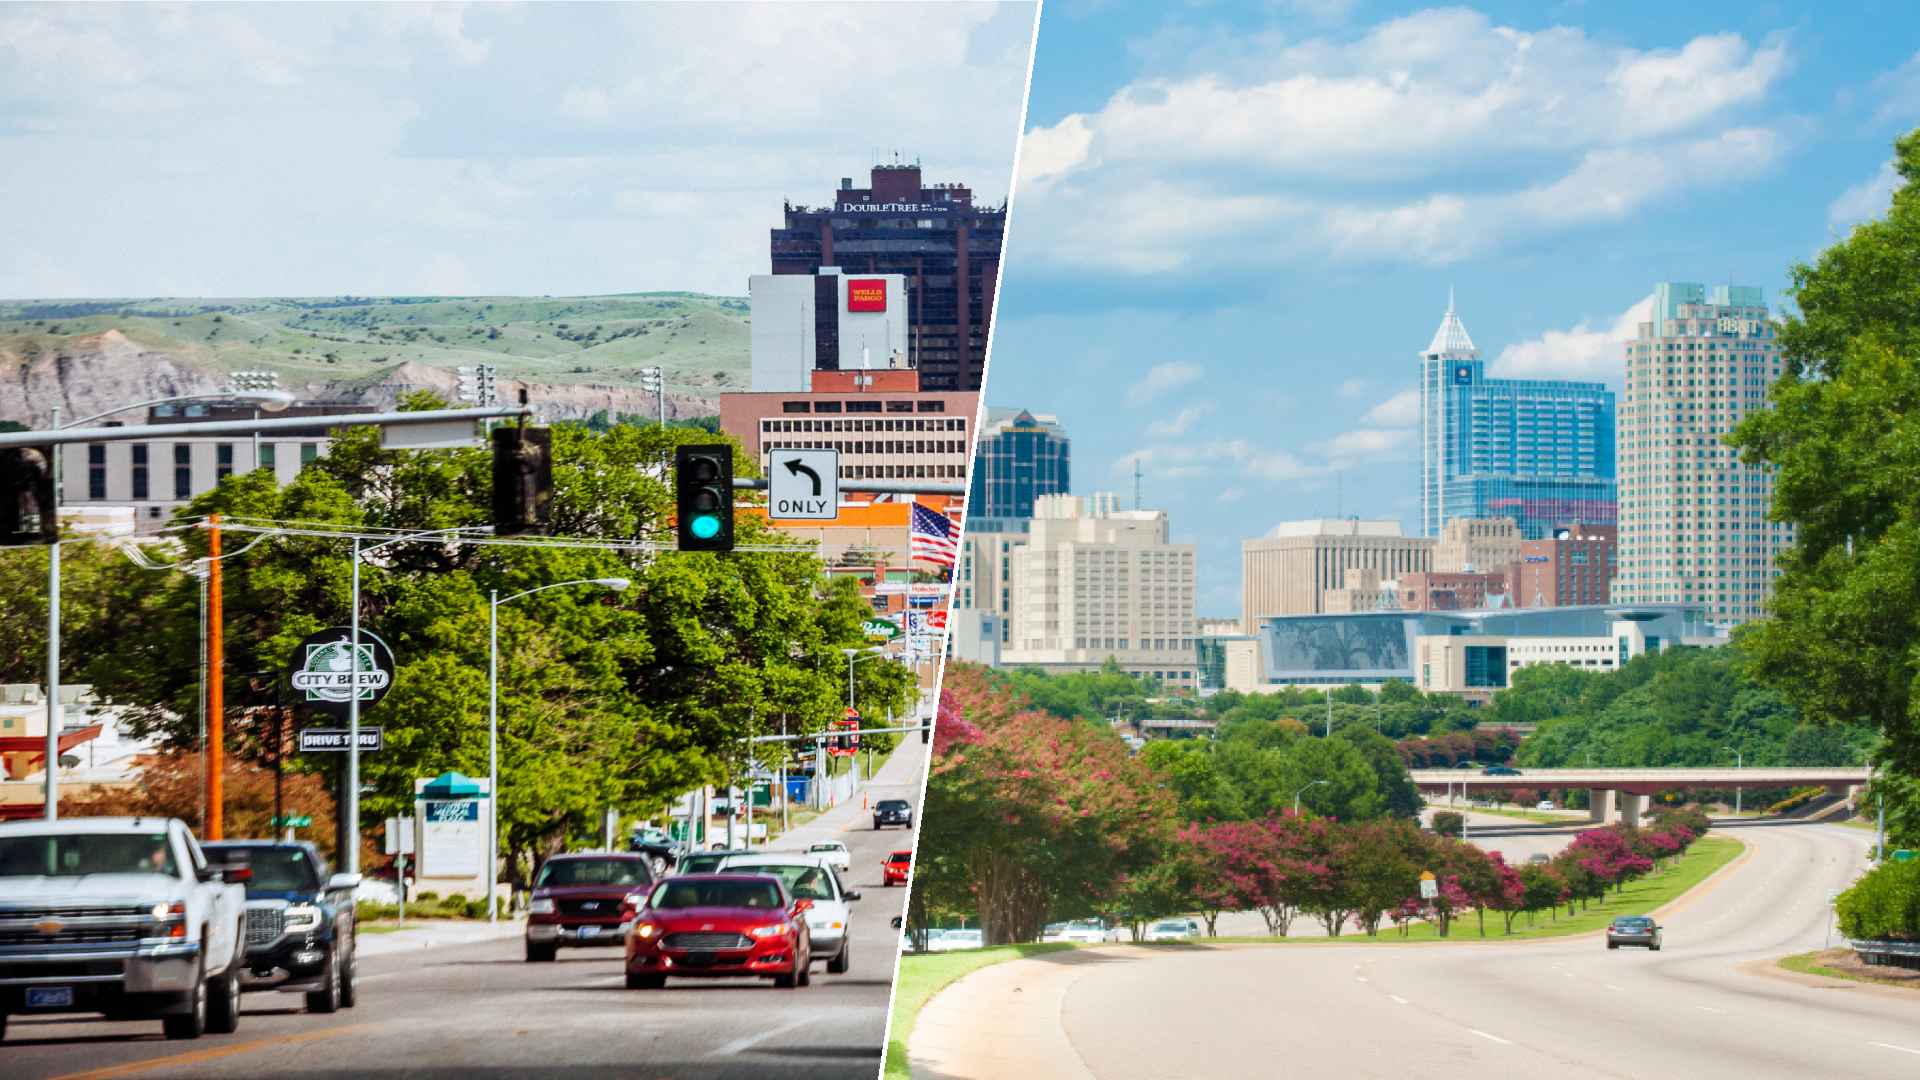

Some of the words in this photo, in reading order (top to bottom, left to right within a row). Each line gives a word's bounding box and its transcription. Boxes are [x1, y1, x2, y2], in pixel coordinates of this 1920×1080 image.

[778, 499, 828, 513] ONLY
[297, 674, 331, 685] CITY
[303, 735, 341, 746] DRIVE
[343, 735, 377, 745] TRU
